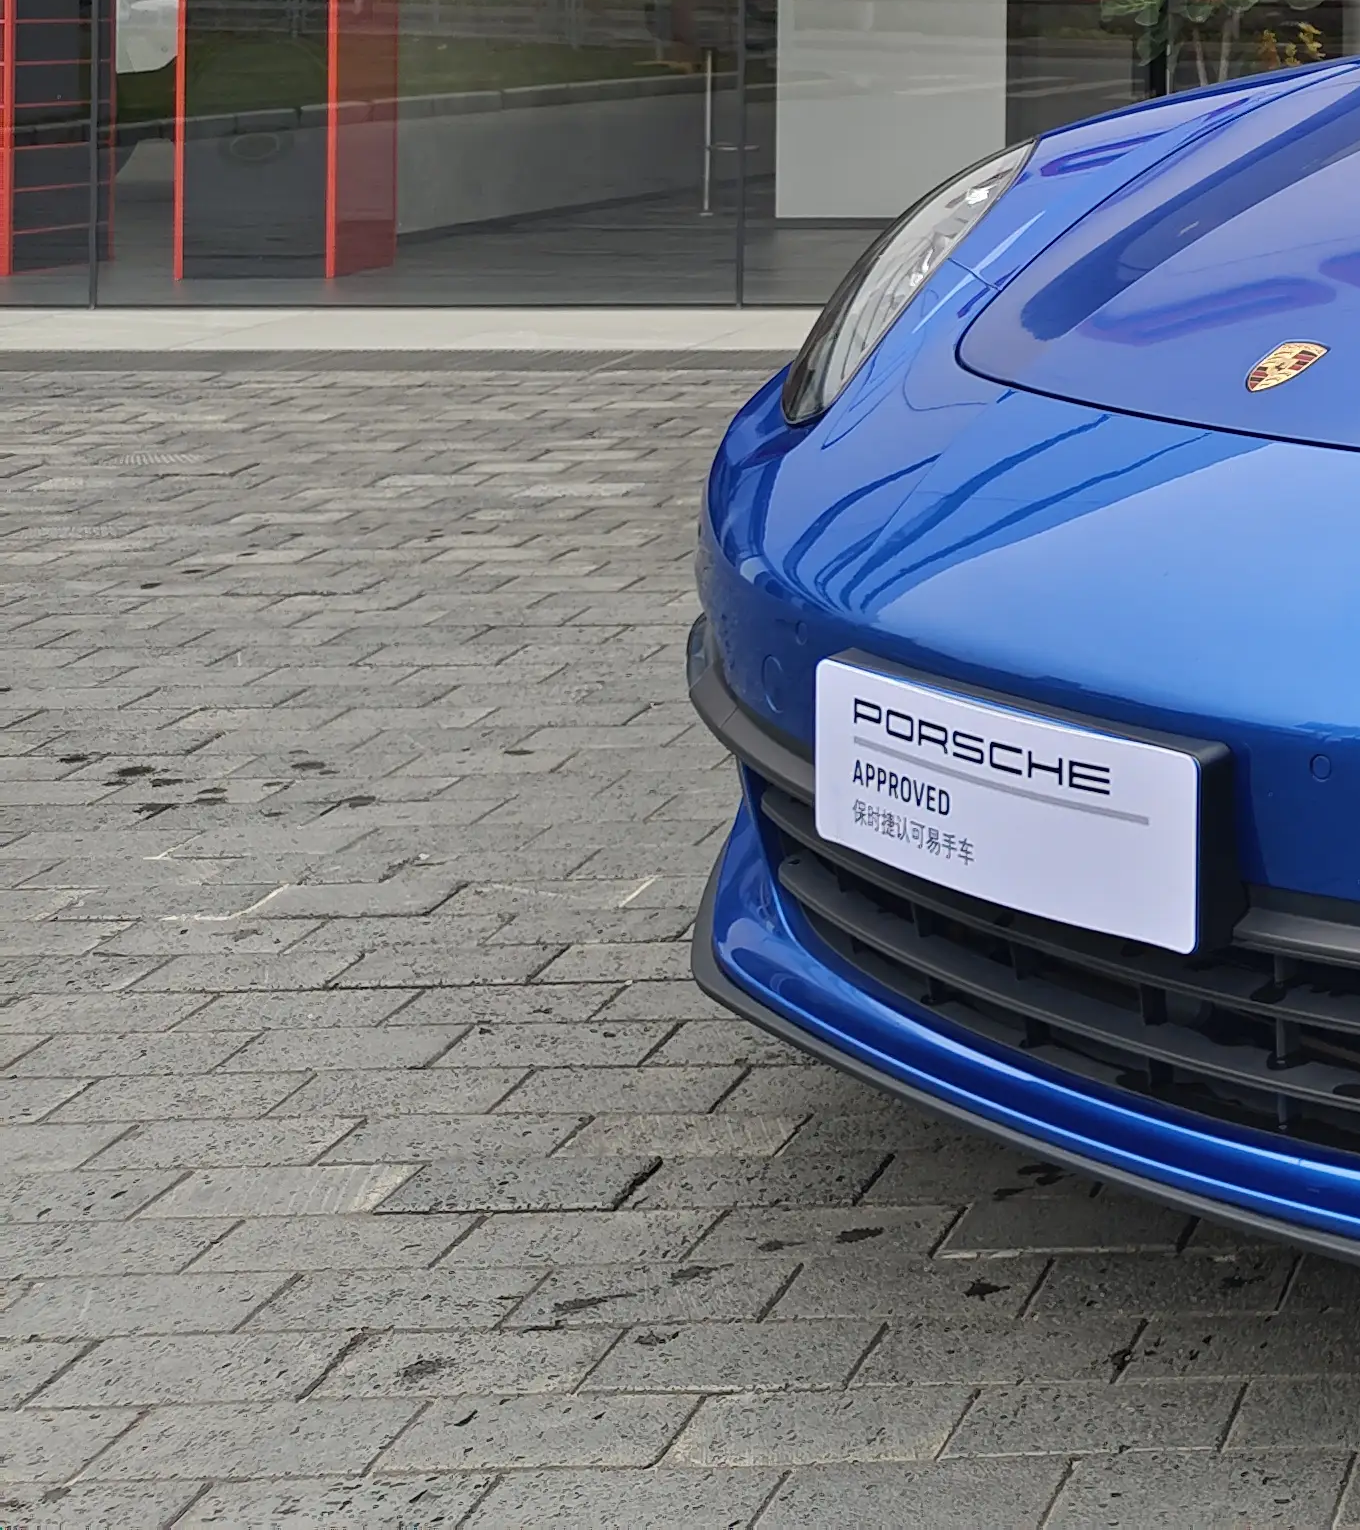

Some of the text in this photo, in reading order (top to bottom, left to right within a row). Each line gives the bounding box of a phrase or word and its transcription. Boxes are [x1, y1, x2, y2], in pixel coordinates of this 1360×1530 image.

[853, 697, 1111, 796] PORSCHE
[852, 759, 951, 816] APPROVED
[852, 798, 975, 866] 保时捷认可易手车
